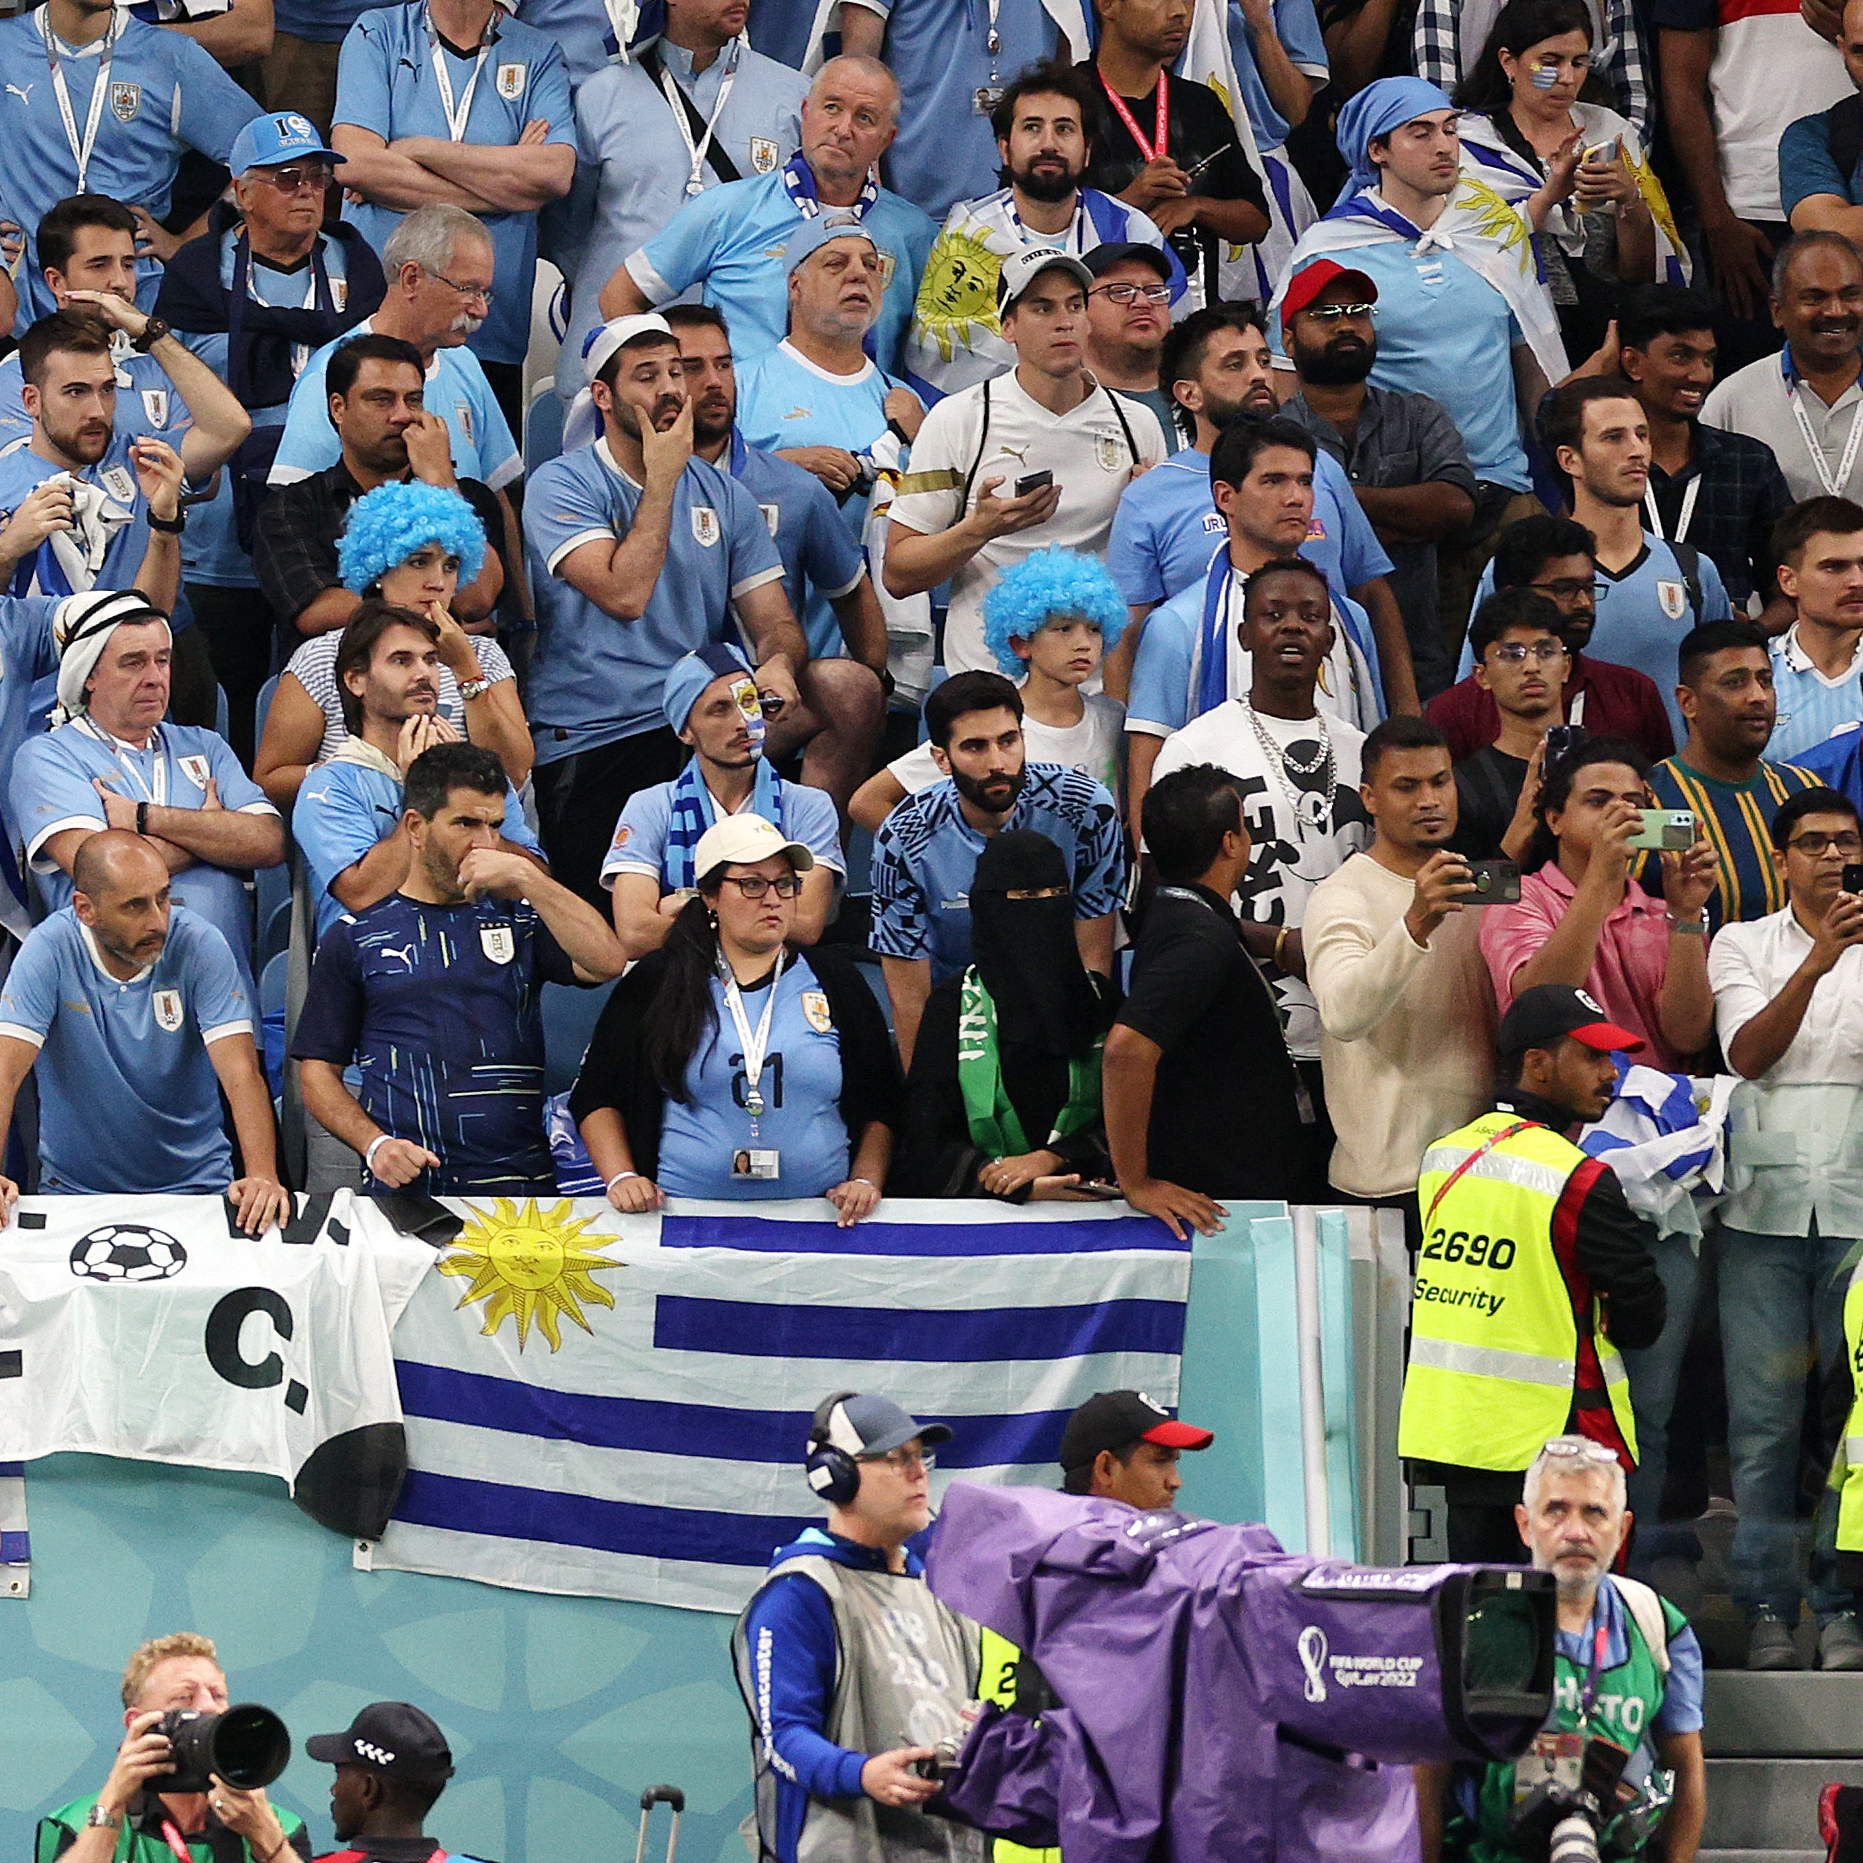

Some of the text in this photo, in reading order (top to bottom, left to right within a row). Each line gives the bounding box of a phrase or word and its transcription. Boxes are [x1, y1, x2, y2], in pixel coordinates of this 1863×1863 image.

[730, 1052, 784, 1109] 21
[1422, 1228, 1515, 1271] 2690
[1414, 1278, 1506, 1317] Security
[204, 1287, 309, 1415] C.
